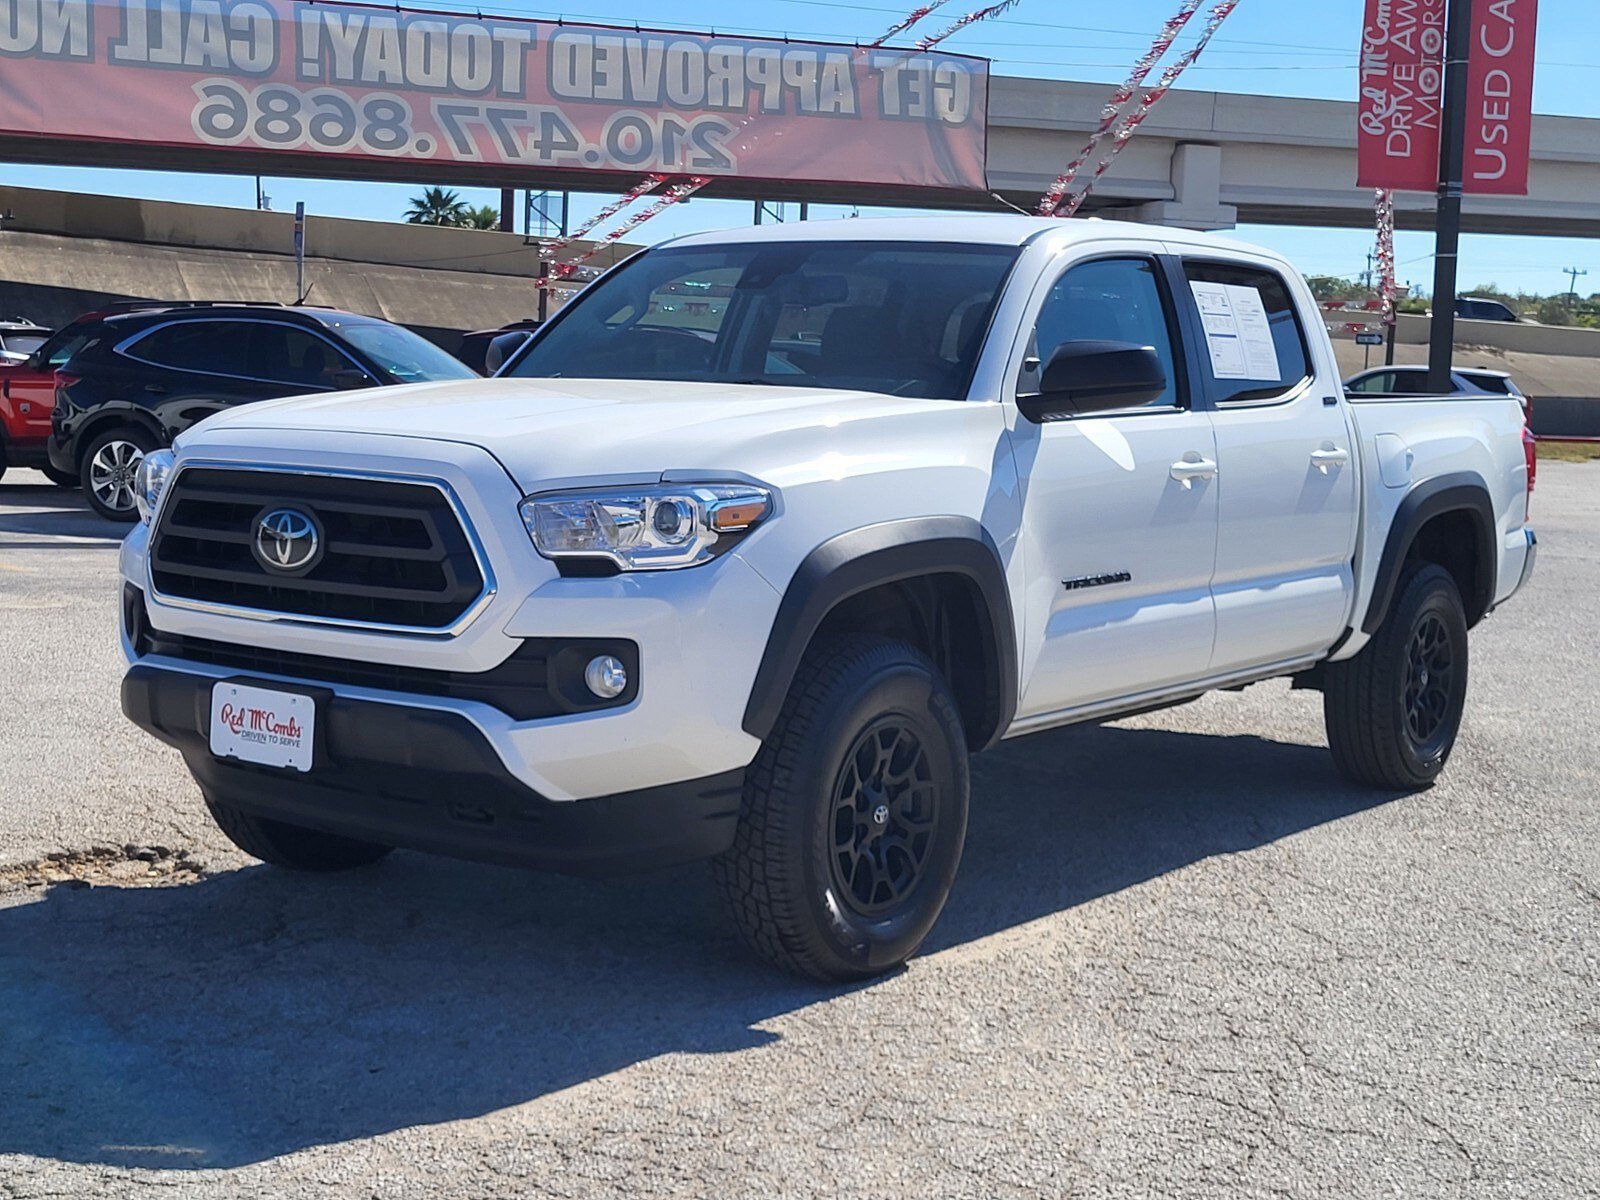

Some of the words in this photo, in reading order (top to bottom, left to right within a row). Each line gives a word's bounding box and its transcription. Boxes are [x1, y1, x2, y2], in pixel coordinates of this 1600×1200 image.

[1480, 0, 1515, 57] CA
[1359, 86, 1395, 136] Red
[1386, 63, 1416, 157] DRIVE
[1473, 69, 1511, 180] USED
[221, 703, 245, 734] Red
[247, 708, 301, 738] McCombs
[241, 730, 267, 742] DRIVEN
[269, 735, 278, 744] TO
[280, 737, 300, 748] SERVE
